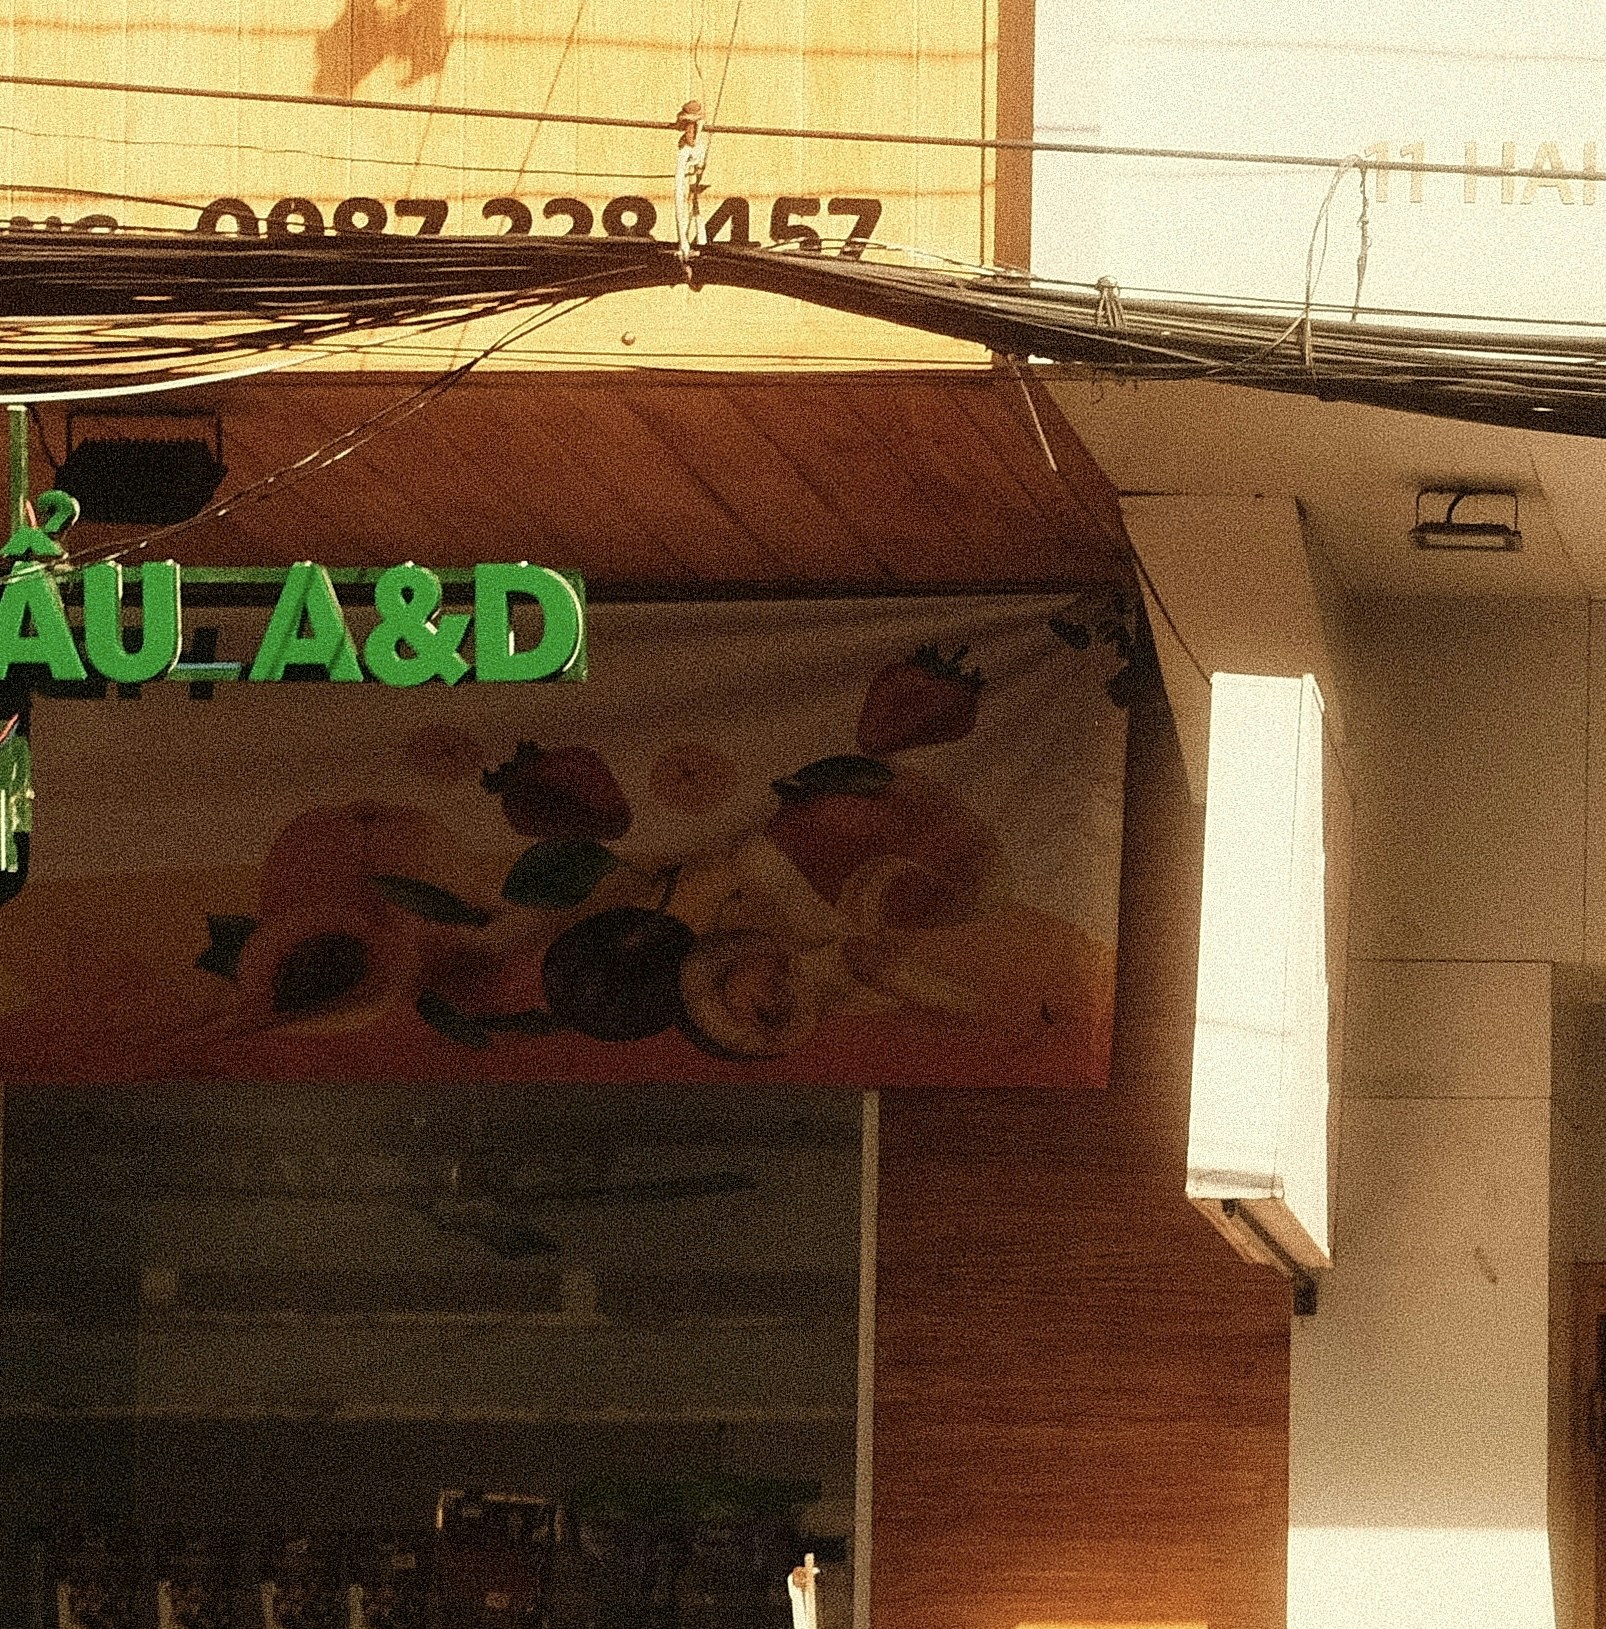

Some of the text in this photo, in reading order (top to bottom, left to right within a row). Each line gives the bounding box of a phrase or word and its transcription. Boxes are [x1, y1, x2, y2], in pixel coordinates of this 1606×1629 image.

[1364, 141, 1426, 204] 11
[1464, 141, 1598, 207] HAI
[249, 560, 584, 686] A&D
